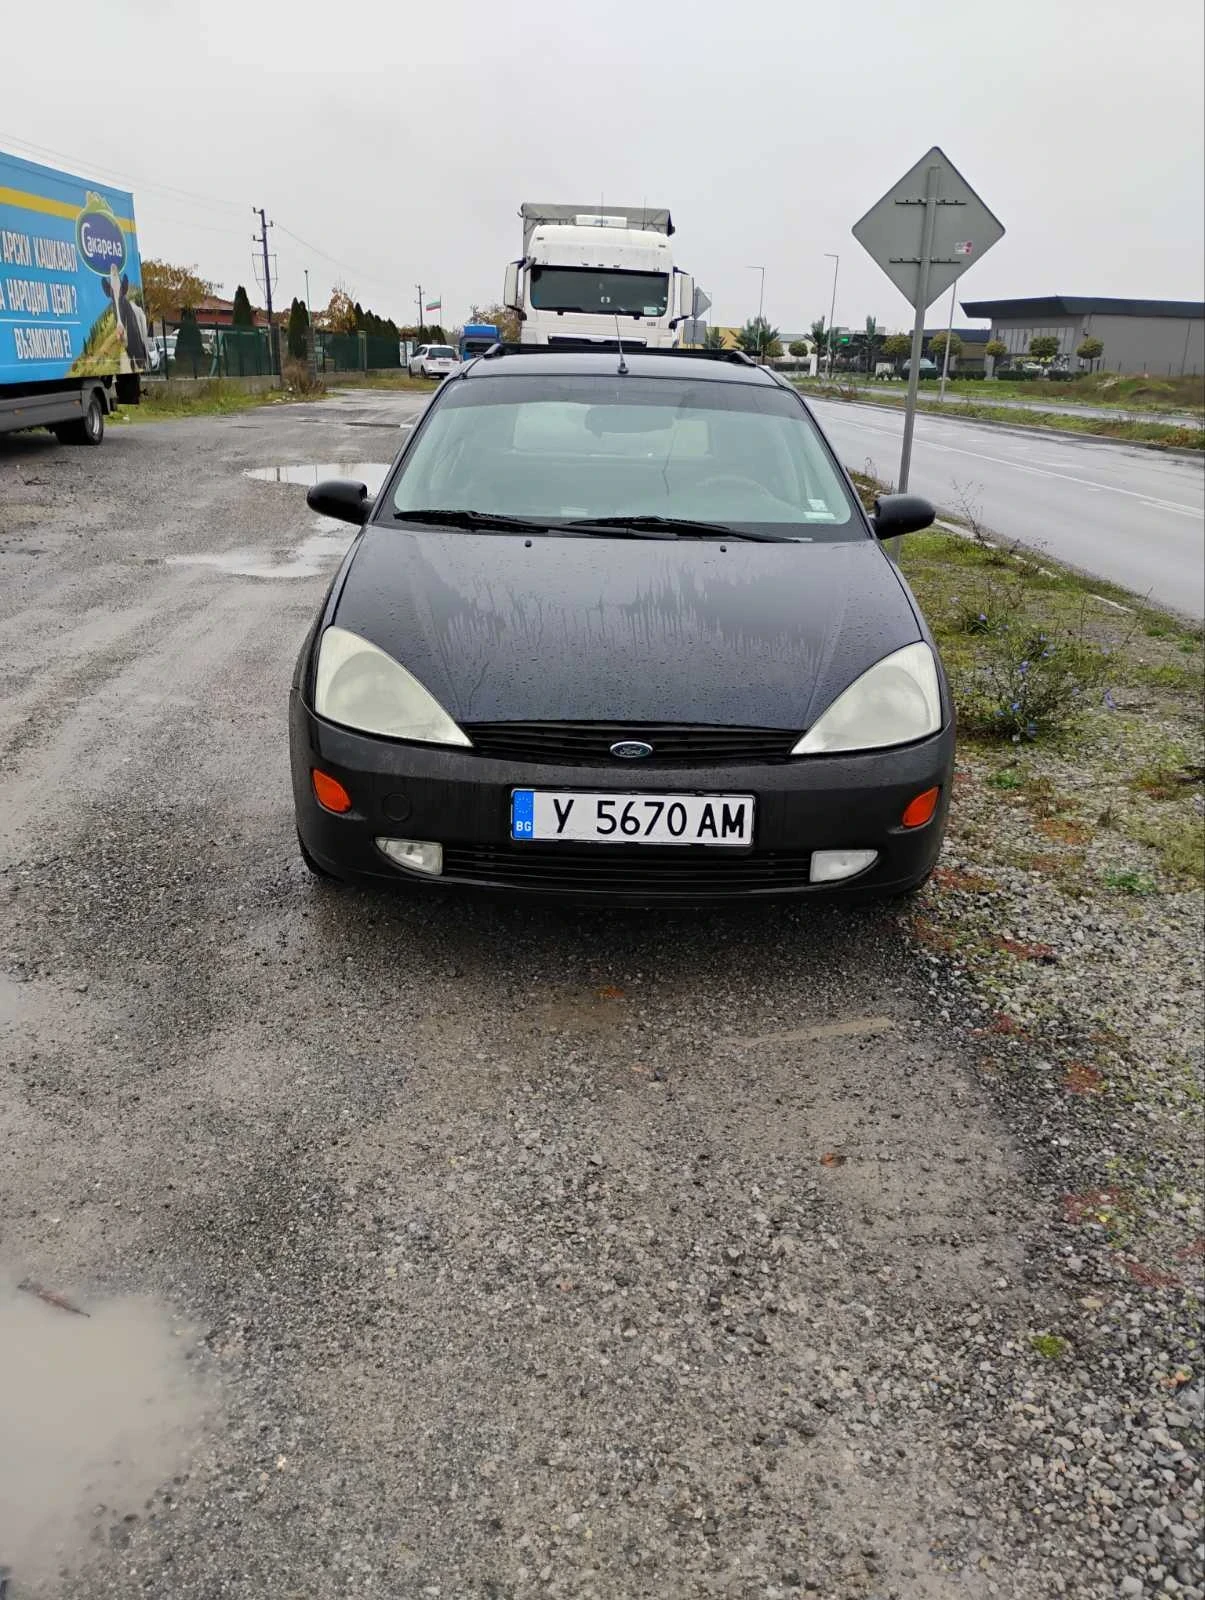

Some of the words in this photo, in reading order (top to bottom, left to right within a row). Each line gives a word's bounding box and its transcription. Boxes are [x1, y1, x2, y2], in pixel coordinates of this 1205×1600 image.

[0, 230, 32, 266] АРСКИ
[33, 237, 78, 272] КАШКАВАЛ
[81, 223, 122, 260] Сакарела
[6, 278, 50, 316] НАРОДНИ
[14, 328, 64, 359] ВЪЗМОЖНО
[515, 821, 533, 832] BG
[596, 800, 688, 836] 5670
